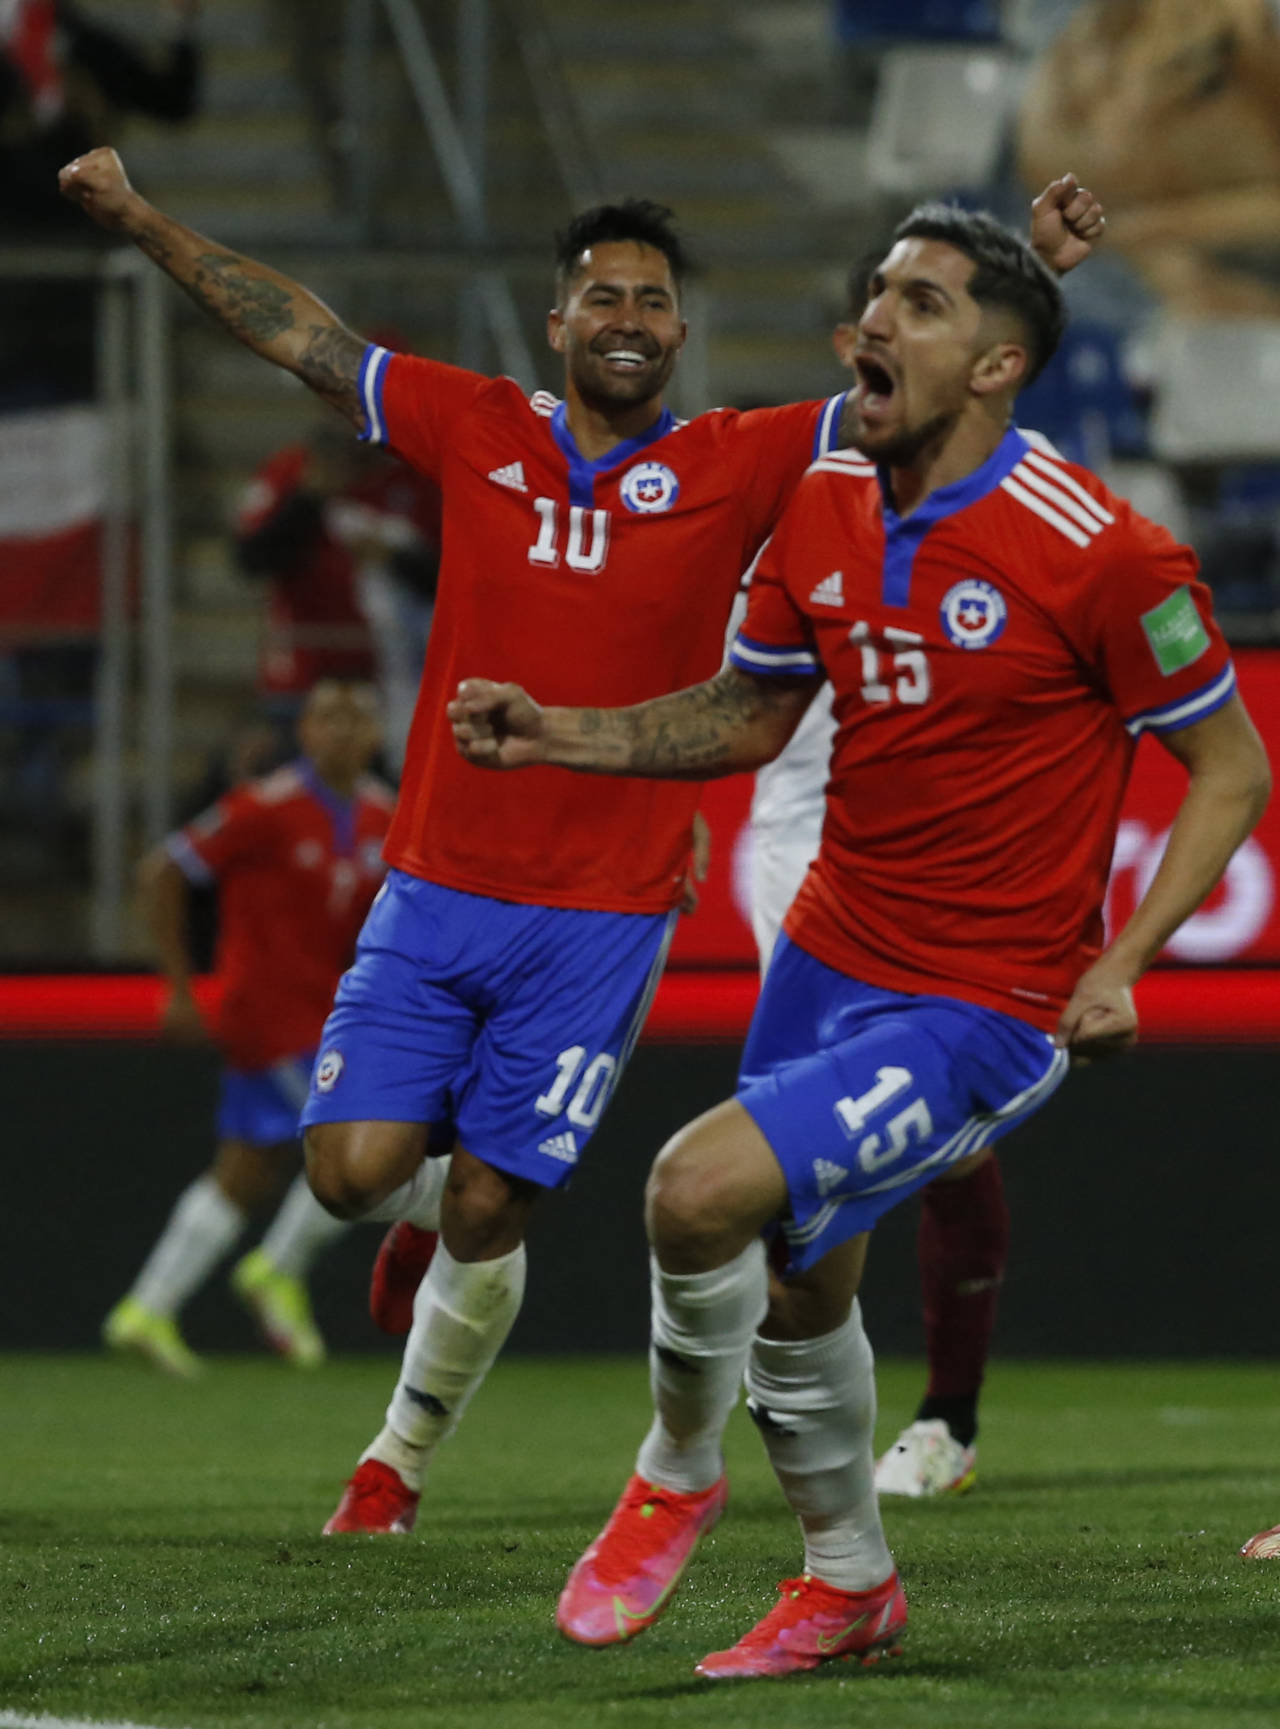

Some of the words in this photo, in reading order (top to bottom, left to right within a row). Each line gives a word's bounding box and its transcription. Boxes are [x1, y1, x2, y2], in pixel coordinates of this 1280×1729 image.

[527, 496, 612, 576] 10
[848, 620, 930, 706] 15
[534, 1045, 617, 1133] 10
[833, 1065, 934, 1175] 15
